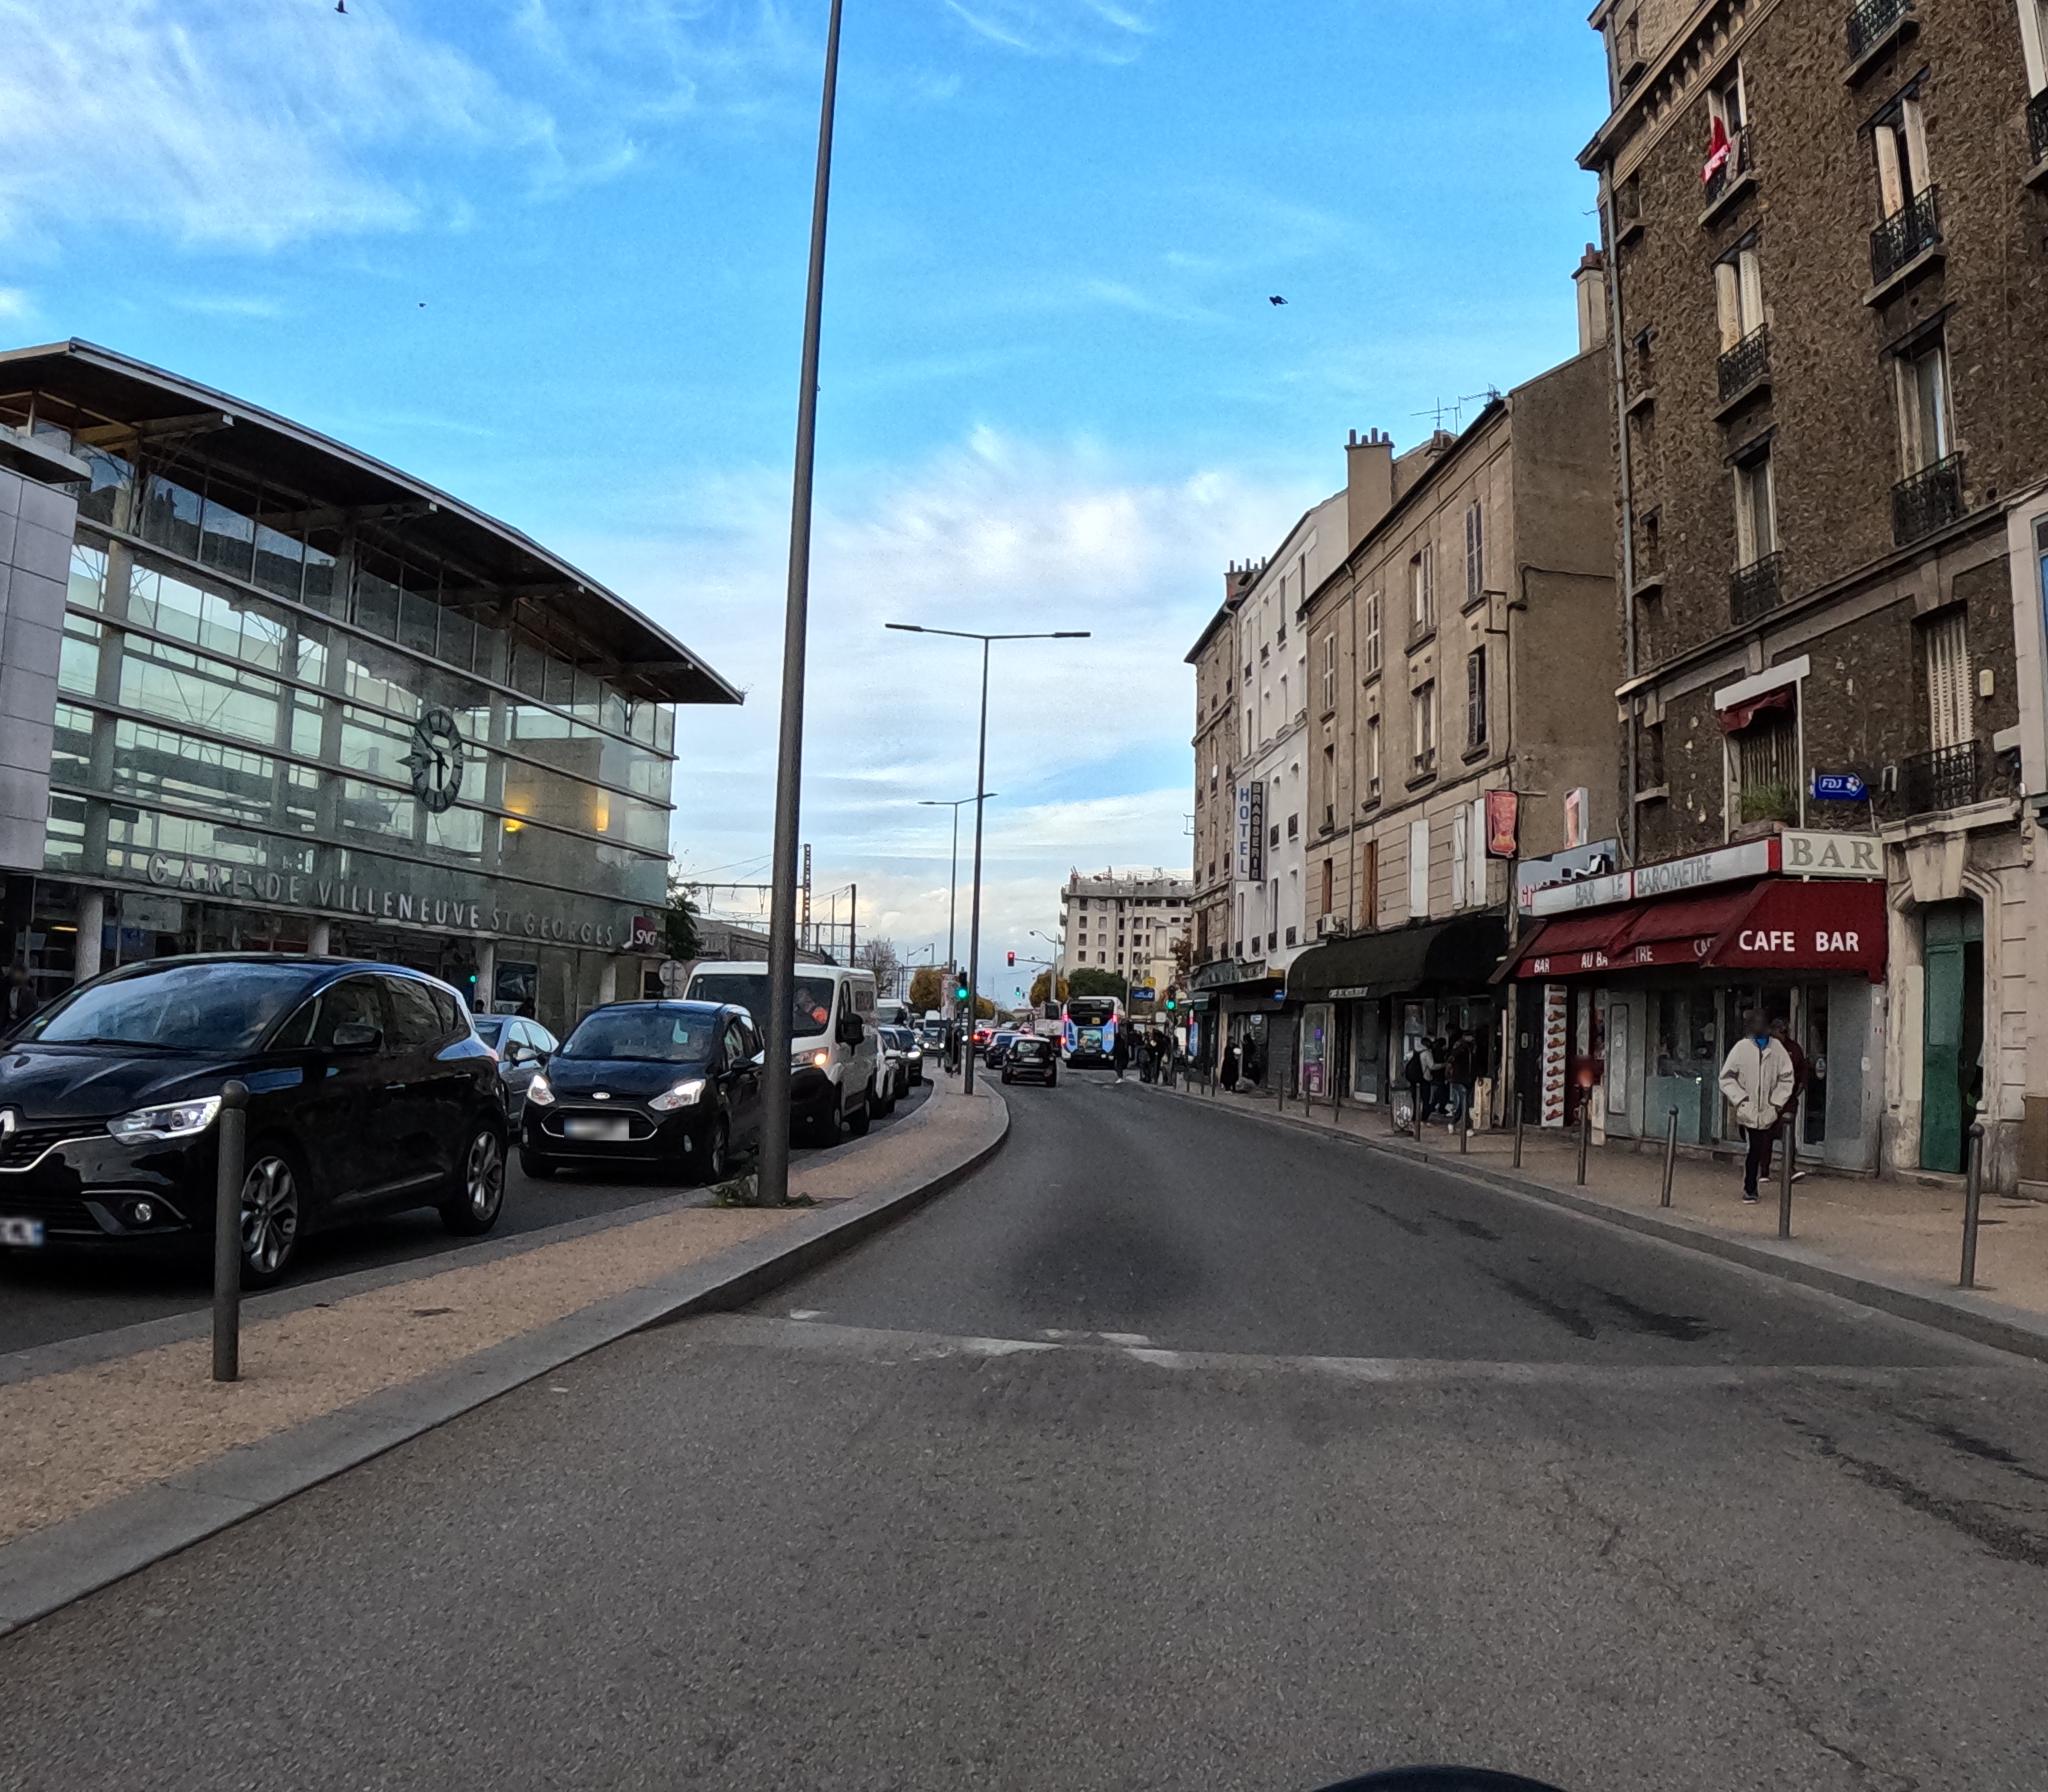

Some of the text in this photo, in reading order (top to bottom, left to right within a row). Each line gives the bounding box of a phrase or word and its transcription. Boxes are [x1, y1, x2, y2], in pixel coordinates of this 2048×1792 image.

[1822, 778, 1842, 789] FDJ
[1239, 787, 1250, 874] HOTEL
[1788, 837, 1878, 870] BAR
[147, 852, 613, 946] GARE DE VILLENEUVE ST GEORGES
[1575, 879, 1596, 907] BAR
[1612, 874, 1624, 899] LE
[1739, 930, 1860, 952] CAFE BAR
[1533, 958, 1550, 974] BAR
[1581, 951, 1594, 969] AU
